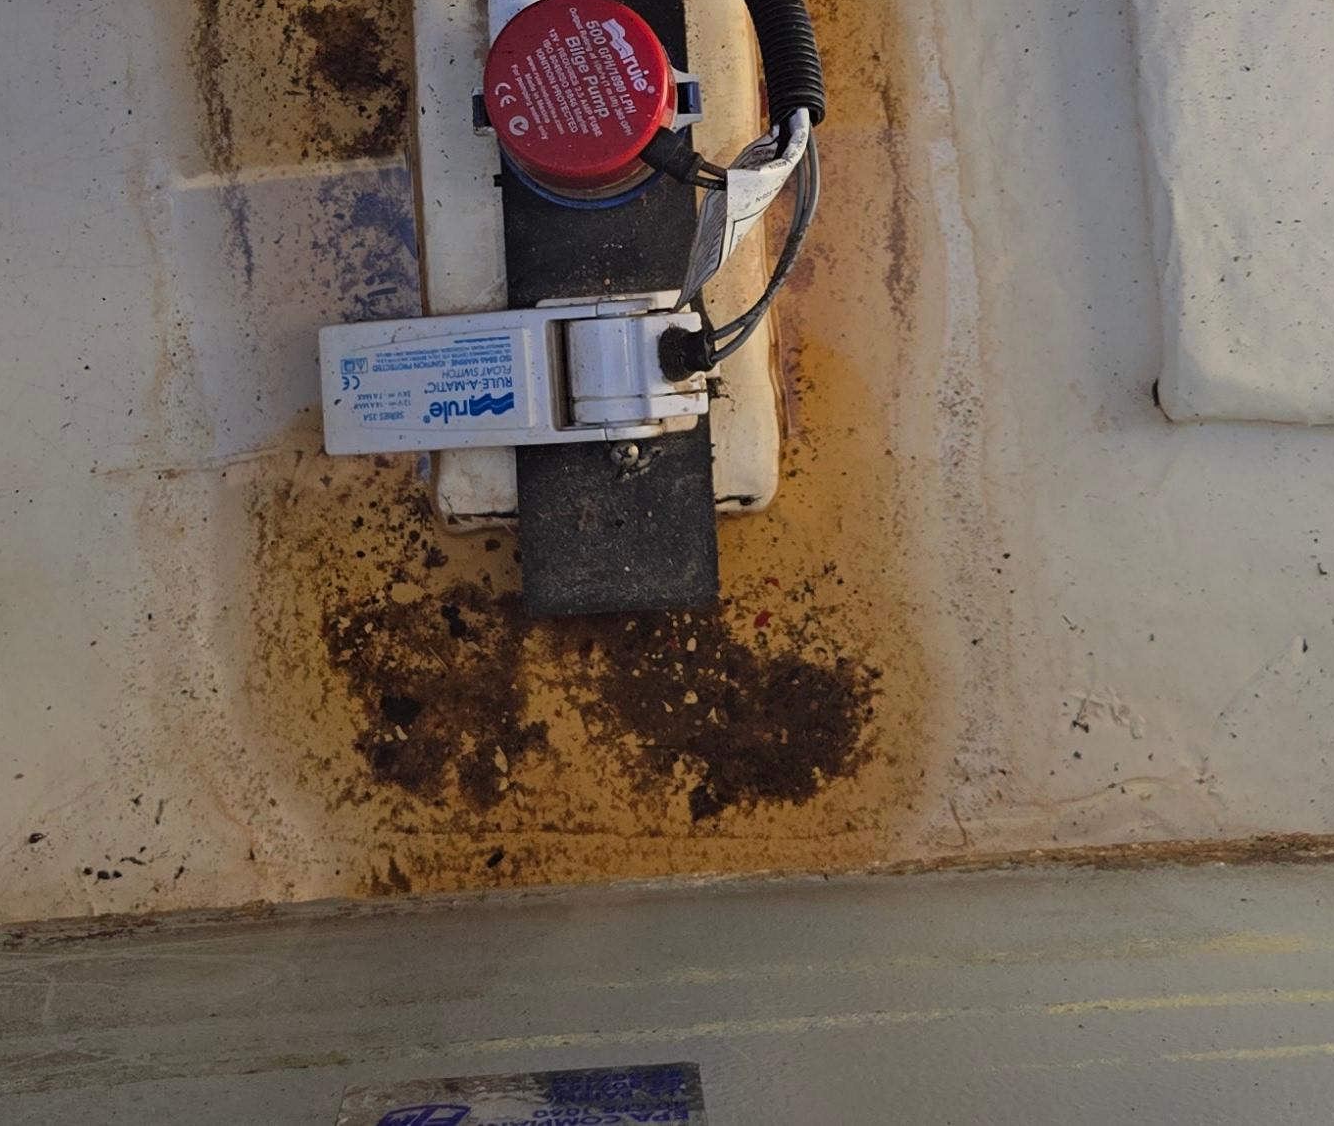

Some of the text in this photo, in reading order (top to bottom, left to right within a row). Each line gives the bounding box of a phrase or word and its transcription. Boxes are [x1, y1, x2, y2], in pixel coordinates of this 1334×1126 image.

[542, 38, 553, 53] ISO
[585, 20, 606, 44] 500
[619, 93, 636, 113] LPH
[564, 35, 609, 117] Bilge Pump
[535, 47, 578, 132] IGNITION PROTECTED
[579, 99, 592, 115] AMP
[588, 115, 602, 136] FUSE
[451, 358, 478, 366] MARINE
[498, 354, 512, 362] ISO
[372, 363, 412, 372] PROTECTED
[442, 364, 511, 378] FLOAT SWITCH
[341, 374, 360, 390] CE
[378, 411, 403, 420] SERIES
[428, 399, 468, 424] rule
